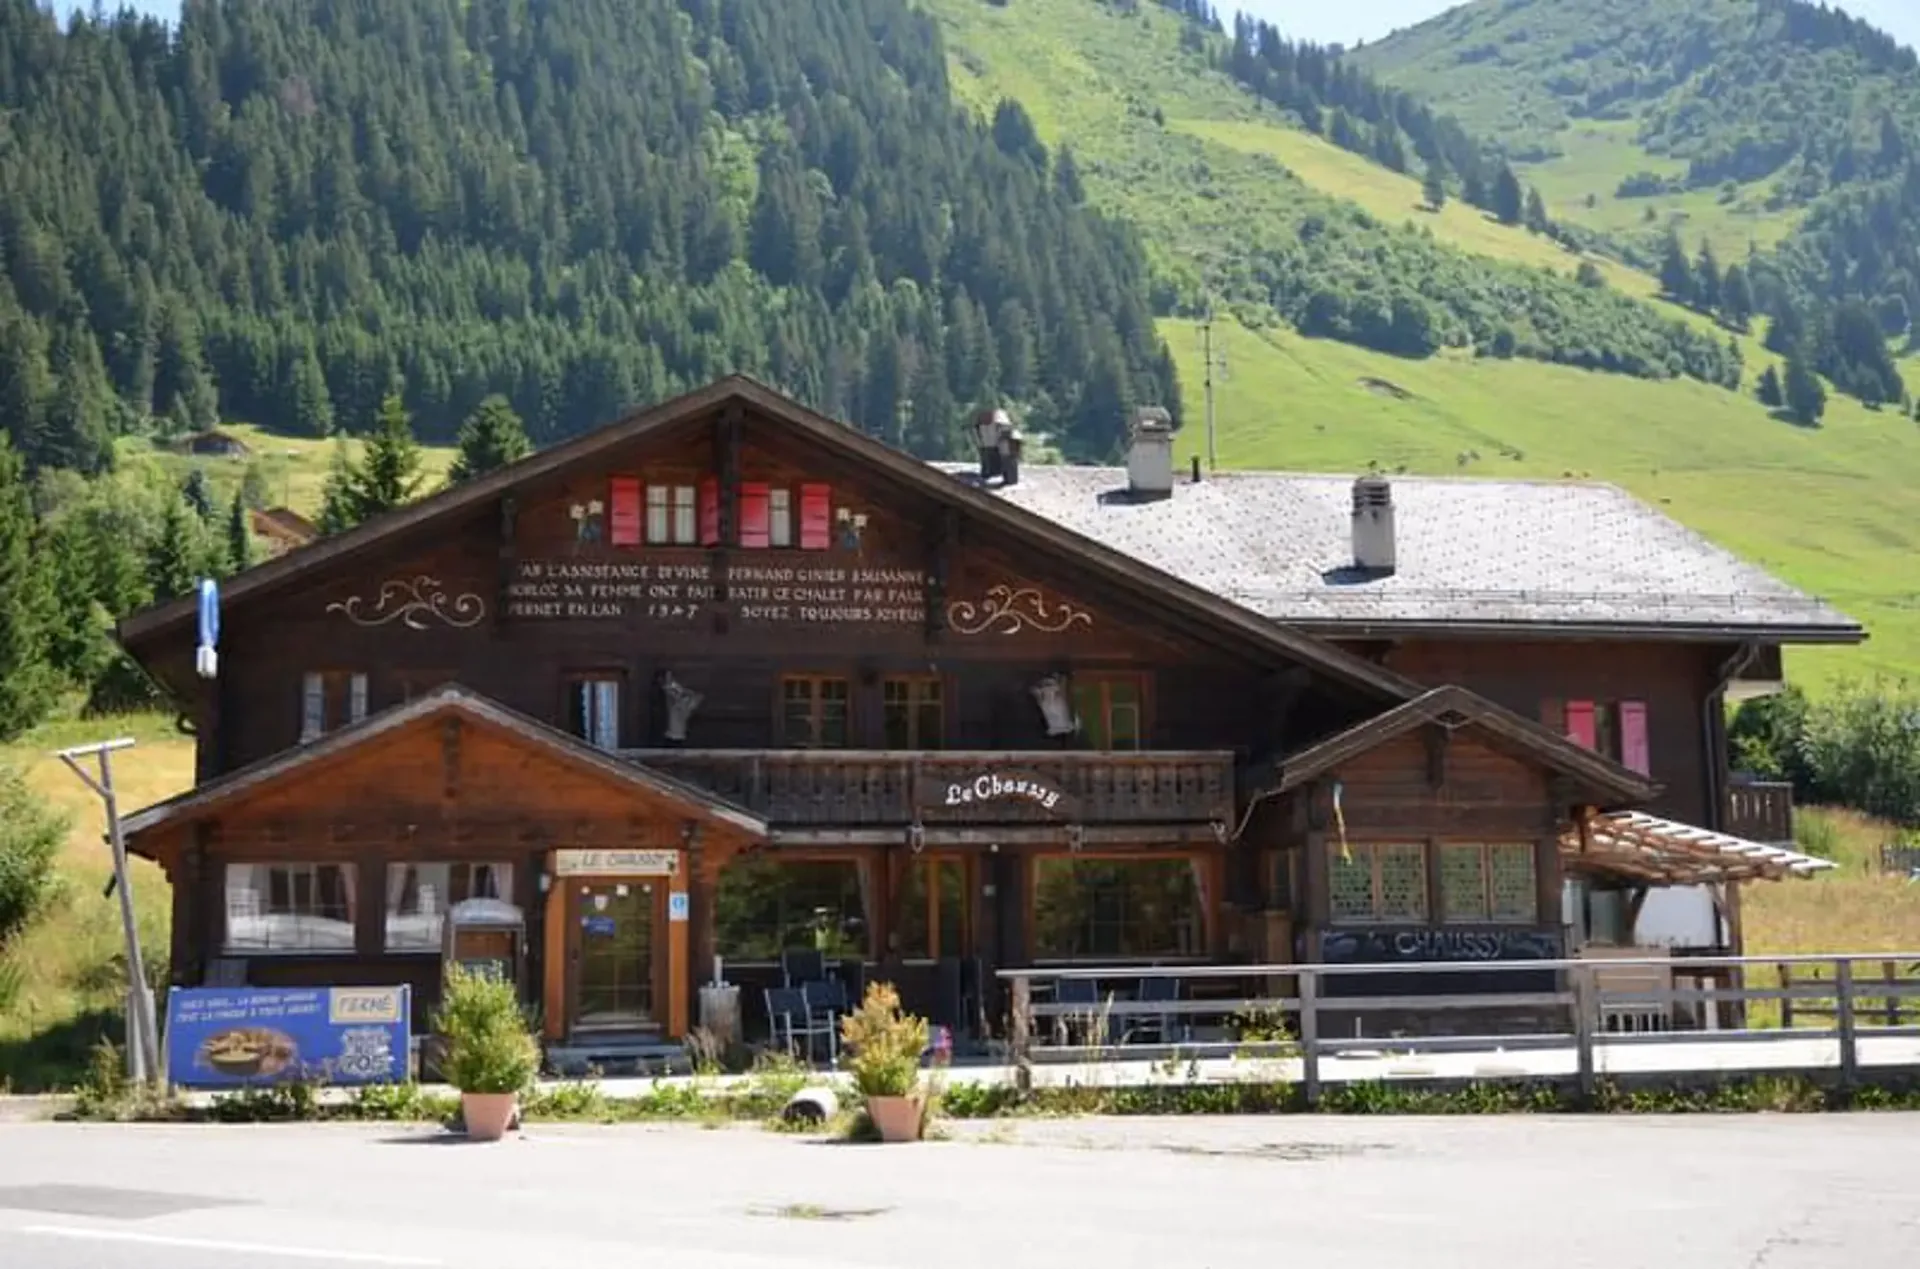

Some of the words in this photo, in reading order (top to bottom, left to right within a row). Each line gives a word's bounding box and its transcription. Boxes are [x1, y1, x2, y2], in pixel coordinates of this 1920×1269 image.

[563, 584, 584, 597] SA
[649, 584, 678, 598] ONT
[793, 587, 846, 602] CHALET
[740, 606, 788, 619] SOYEZ
[945, 783, 973, 805] Le
[974, 773, 1061, 809] Chaussy
